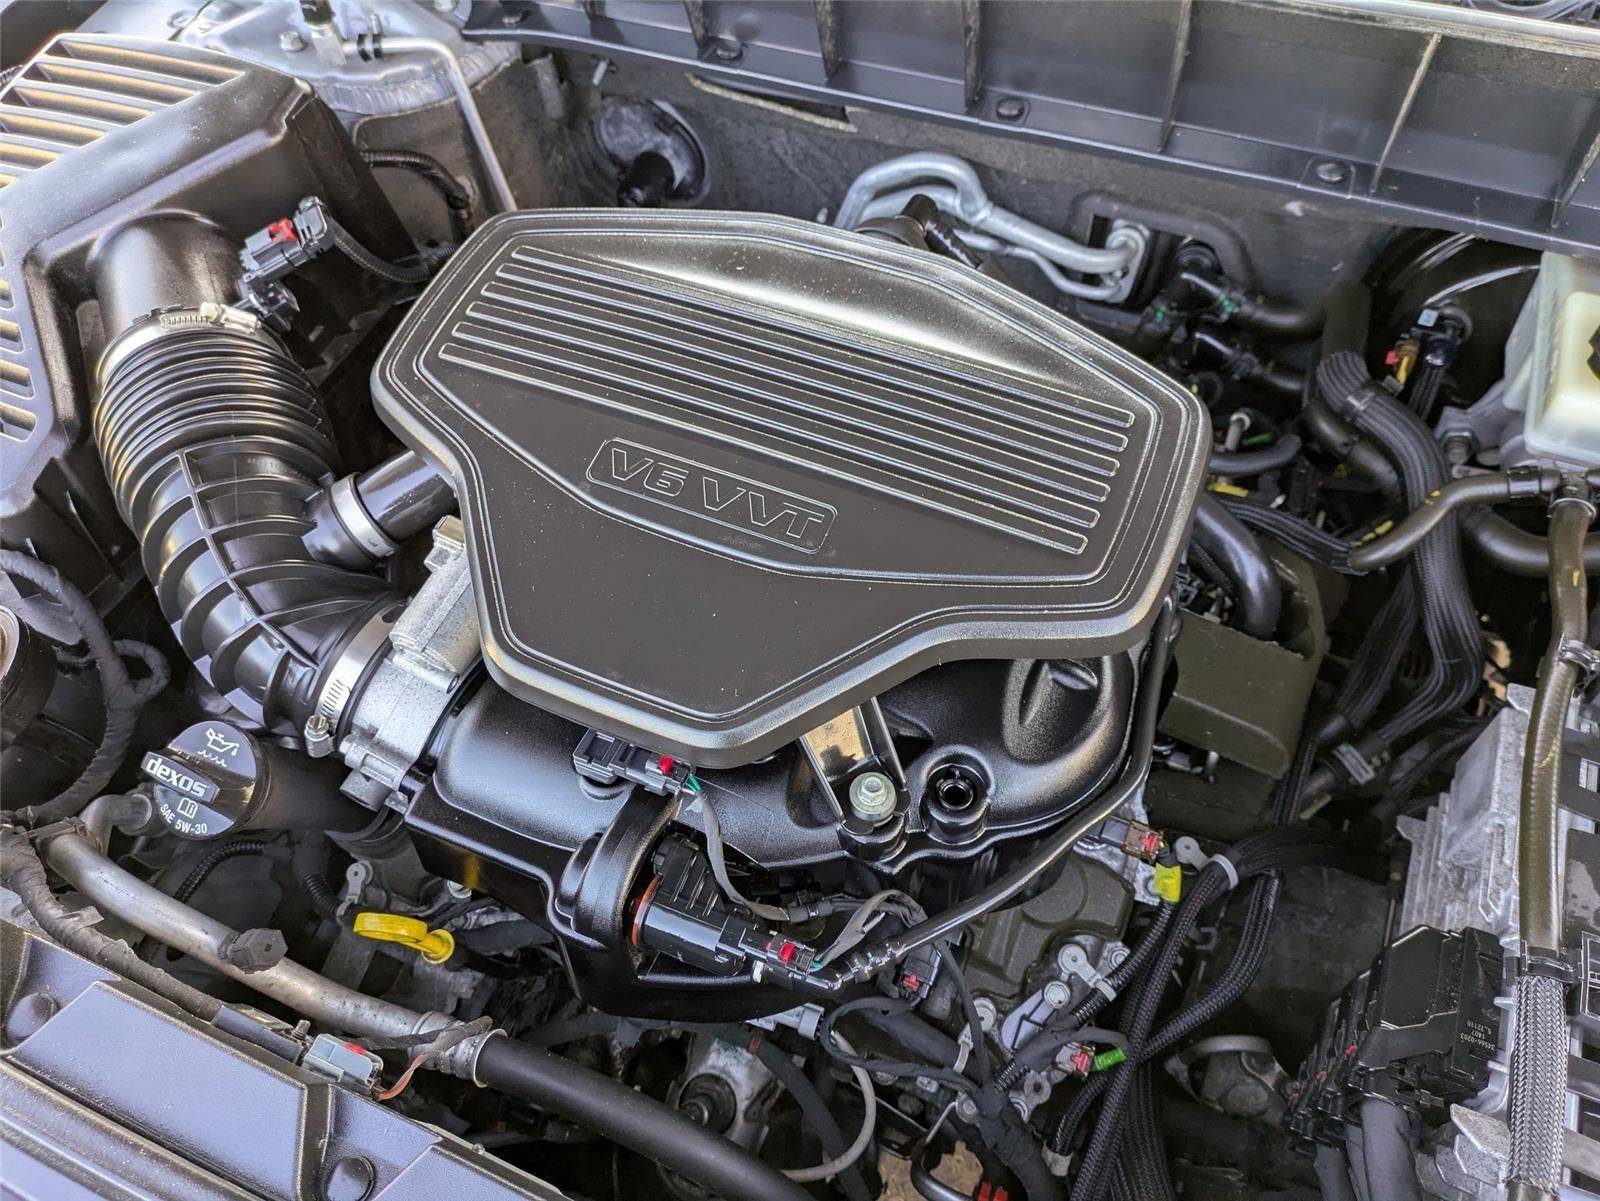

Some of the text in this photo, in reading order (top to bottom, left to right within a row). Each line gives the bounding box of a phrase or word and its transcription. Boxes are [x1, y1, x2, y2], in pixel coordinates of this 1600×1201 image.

[612, 448, 825, 538] V6 VVT
[147, 757, 206, 797] dexos
[160, 804, 207, 834] SAE 5W-30
